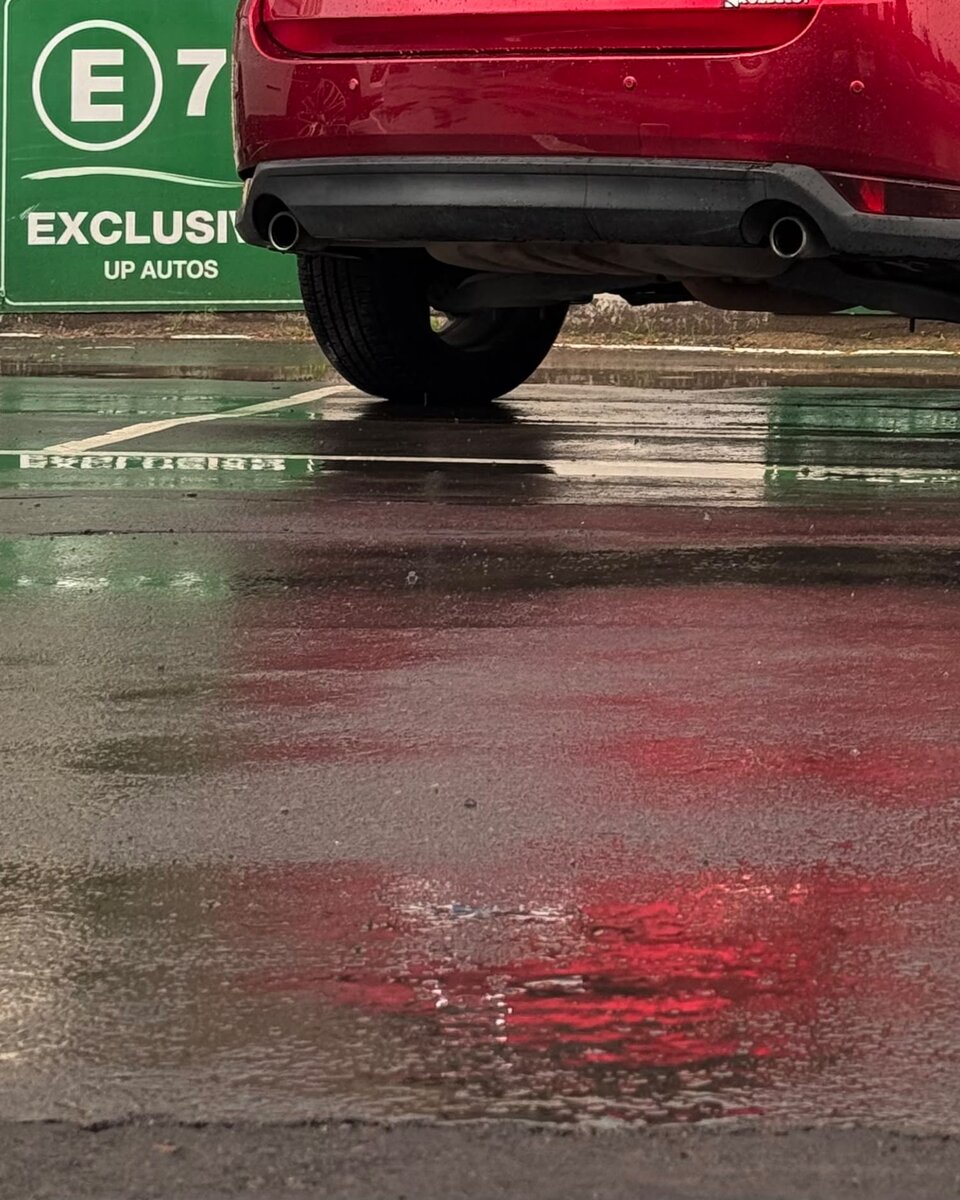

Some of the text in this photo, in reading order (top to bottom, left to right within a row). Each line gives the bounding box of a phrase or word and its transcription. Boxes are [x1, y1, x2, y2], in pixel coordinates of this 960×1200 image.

[71, 49, 124, 122] E
[104, 259, 219, 280] UP AUTOS
